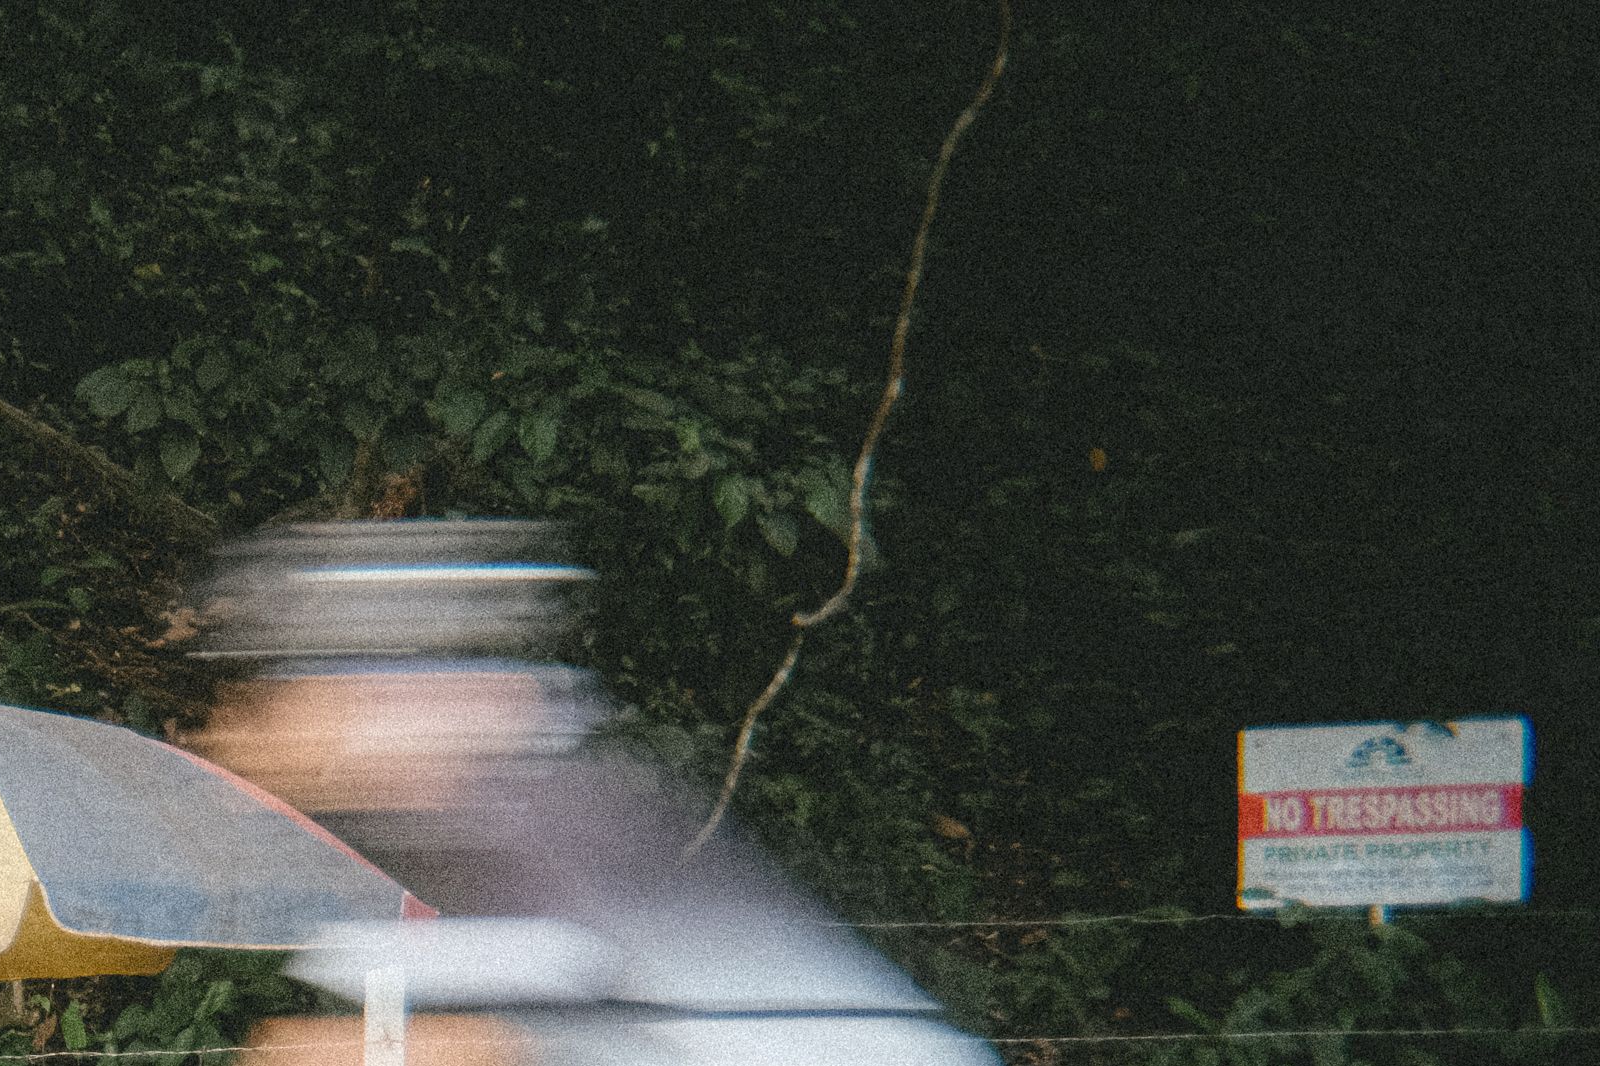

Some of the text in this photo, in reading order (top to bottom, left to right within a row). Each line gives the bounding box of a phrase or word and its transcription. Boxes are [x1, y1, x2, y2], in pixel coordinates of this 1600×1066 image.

[1264, 791, 1501, 832] NO TRESPASSING
[1264, 839, 1490, 862] PRIVATE PROPERTY
